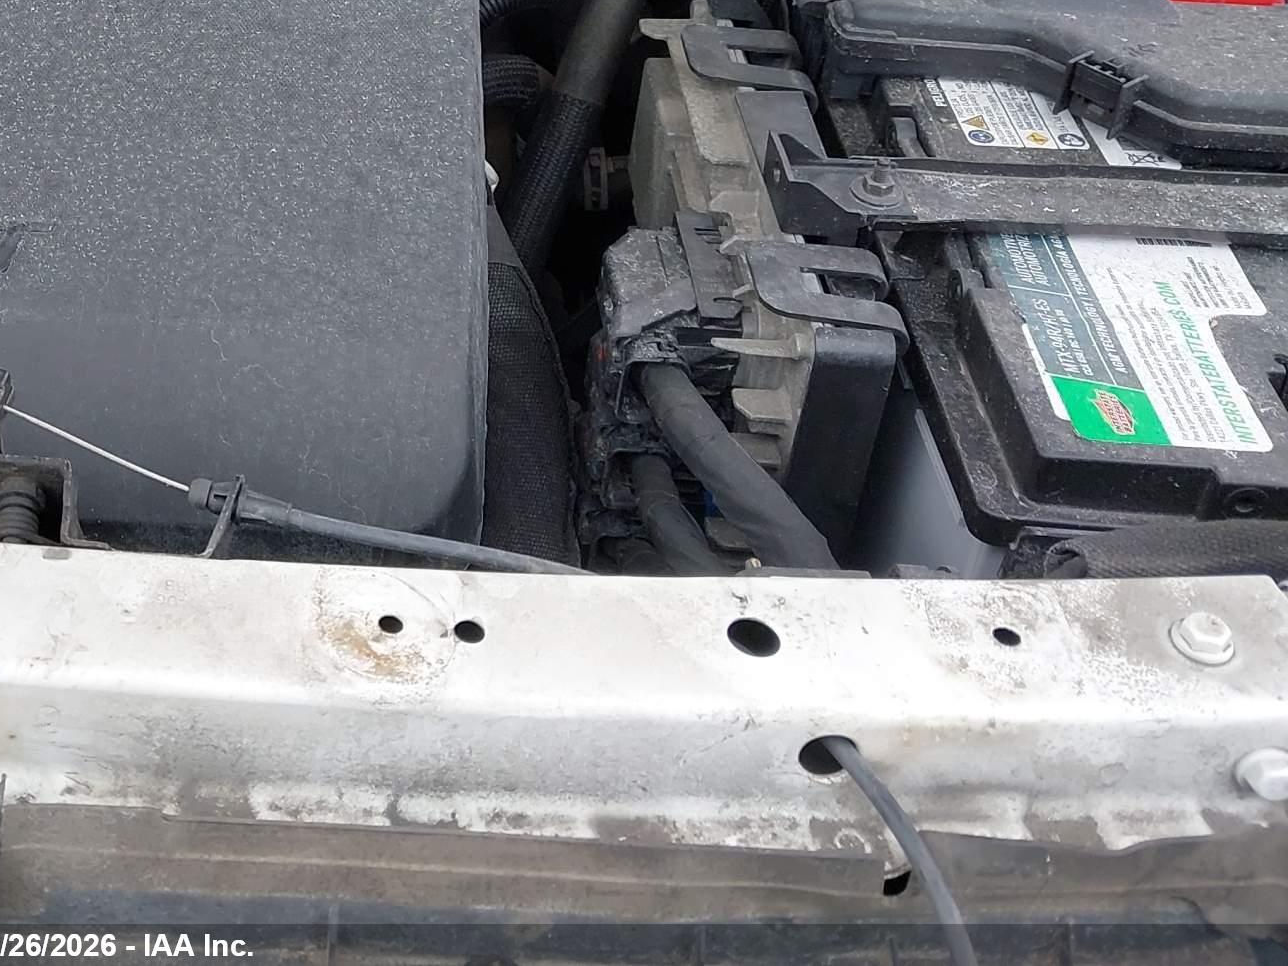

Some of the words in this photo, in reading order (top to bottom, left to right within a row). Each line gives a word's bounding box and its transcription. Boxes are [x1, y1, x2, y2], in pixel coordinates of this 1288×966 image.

[924, 78, 948, 107] PELIGRO
[1001, 235, 1032, 283] AUTOMOTIVE
[1056, 250, 1088, 295] TECNOLOGÍA
[1082, 301, 1115, 353] TECHNOLOGY
[1153, 282, 1258, 443] INTERSTATEBATTERIES.COM
[1099, 392, 1123, 432] INTERSTATE
[1108, 395, 1133, 433] BATTERIES
